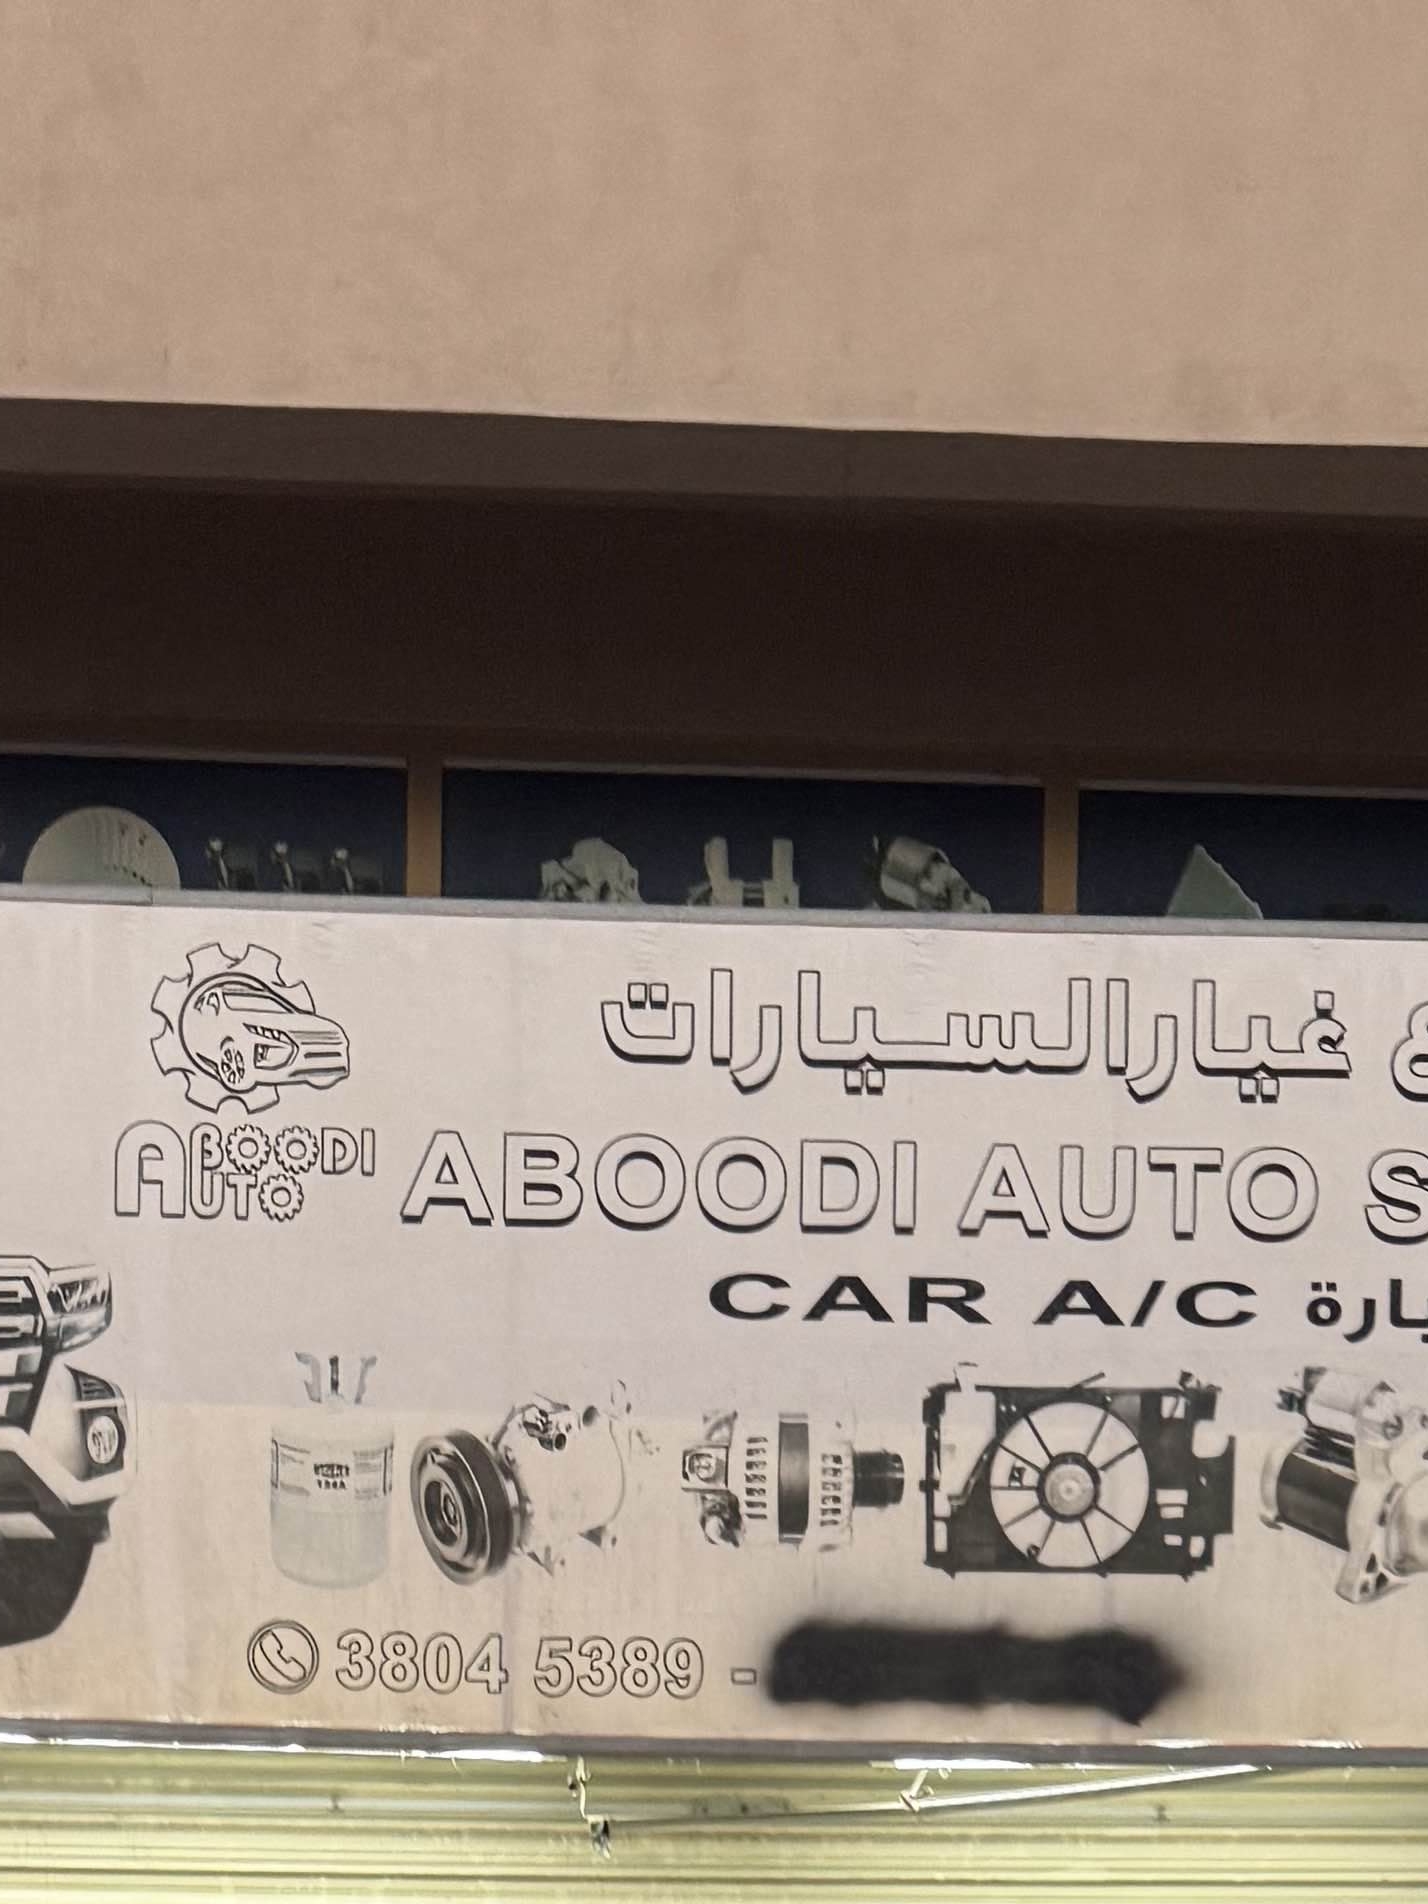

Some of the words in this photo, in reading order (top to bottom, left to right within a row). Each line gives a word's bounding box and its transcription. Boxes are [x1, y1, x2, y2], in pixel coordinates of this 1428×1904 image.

[400, 1130, 918, 1235] ABOODI
[957, 1142, 1319, 1244] AUTO
[709, 1273, 992, 1325] CAR
[1032, 1279, 1258, 1328] A/C
[335, 1628, 509, 1695] 3804
[534, 1636, 704, 1699] 5389
